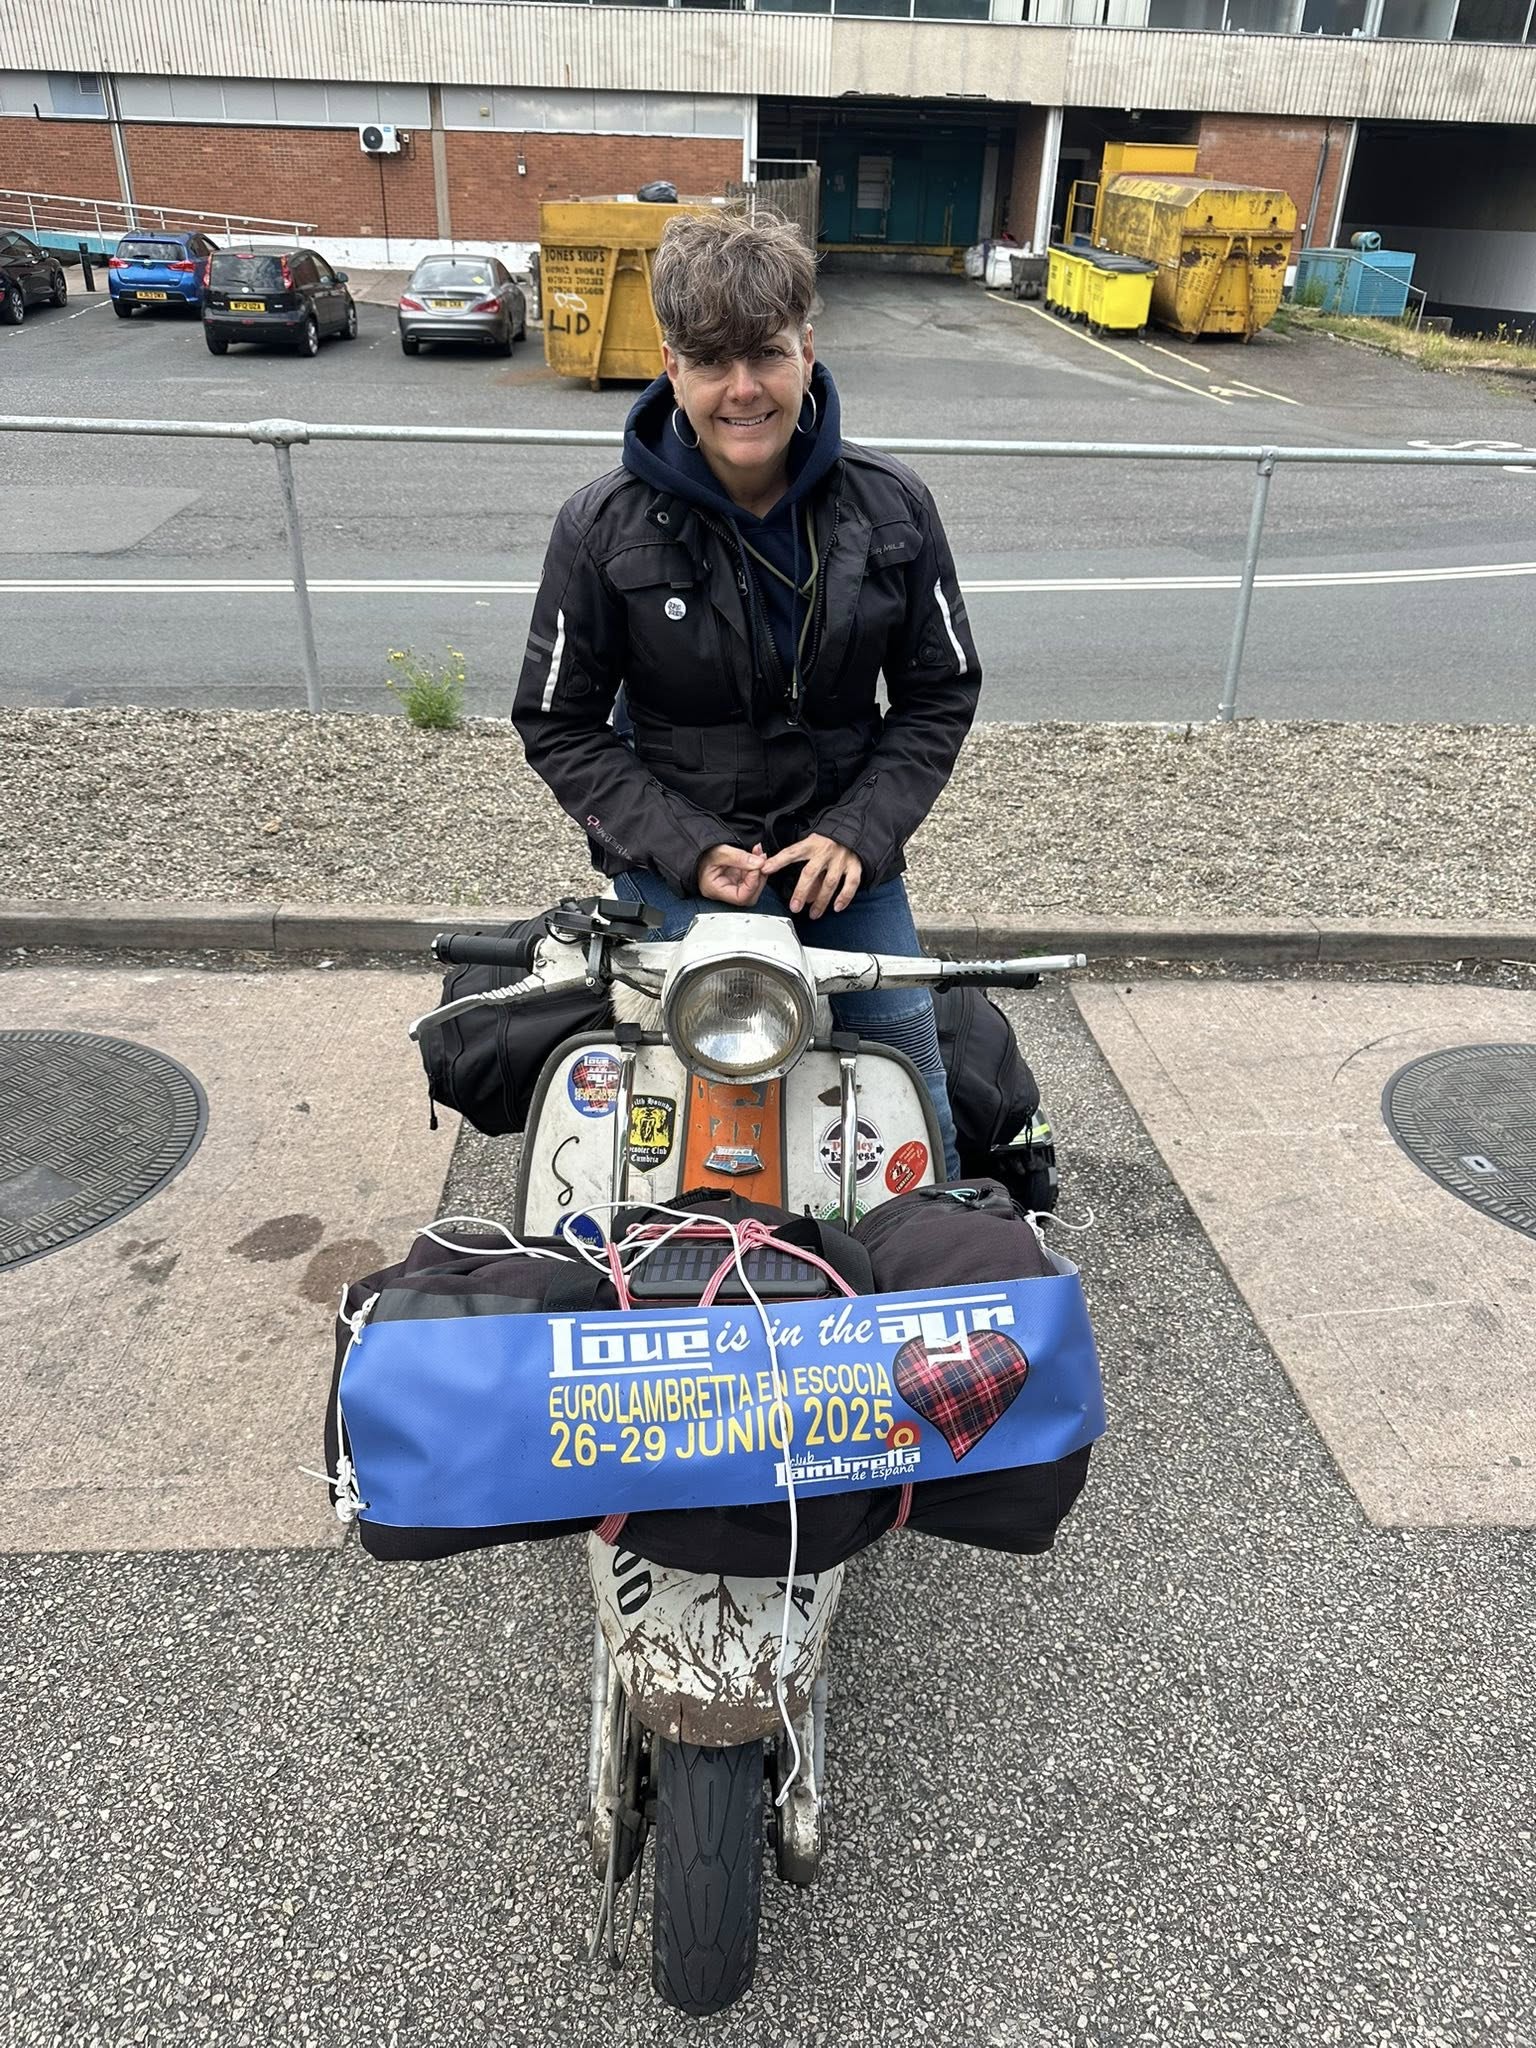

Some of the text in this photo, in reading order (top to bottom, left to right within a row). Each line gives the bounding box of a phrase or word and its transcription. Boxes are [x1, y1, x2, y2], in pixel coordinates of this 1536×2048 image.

[544, 249, 605, 263] JONES SKIPS
[548, 309, 591, 335] LID
[630, 1154, 659, 1163] Cumbria
[651, 1147, 668, 1155] Club
[547, 1293, 1015, 1378] Love is in the ayr
[549, 1362, 893, 1424] EUROLAMBRETTA EN ESCOCIA
[550, 1396, 895, 1468] 26-29 JUNIO 2025
[774, 1447, 921, 1487] Lambretta
[789, 1451, 815, 1465] club
[851, 1470, 867, 1481] de
